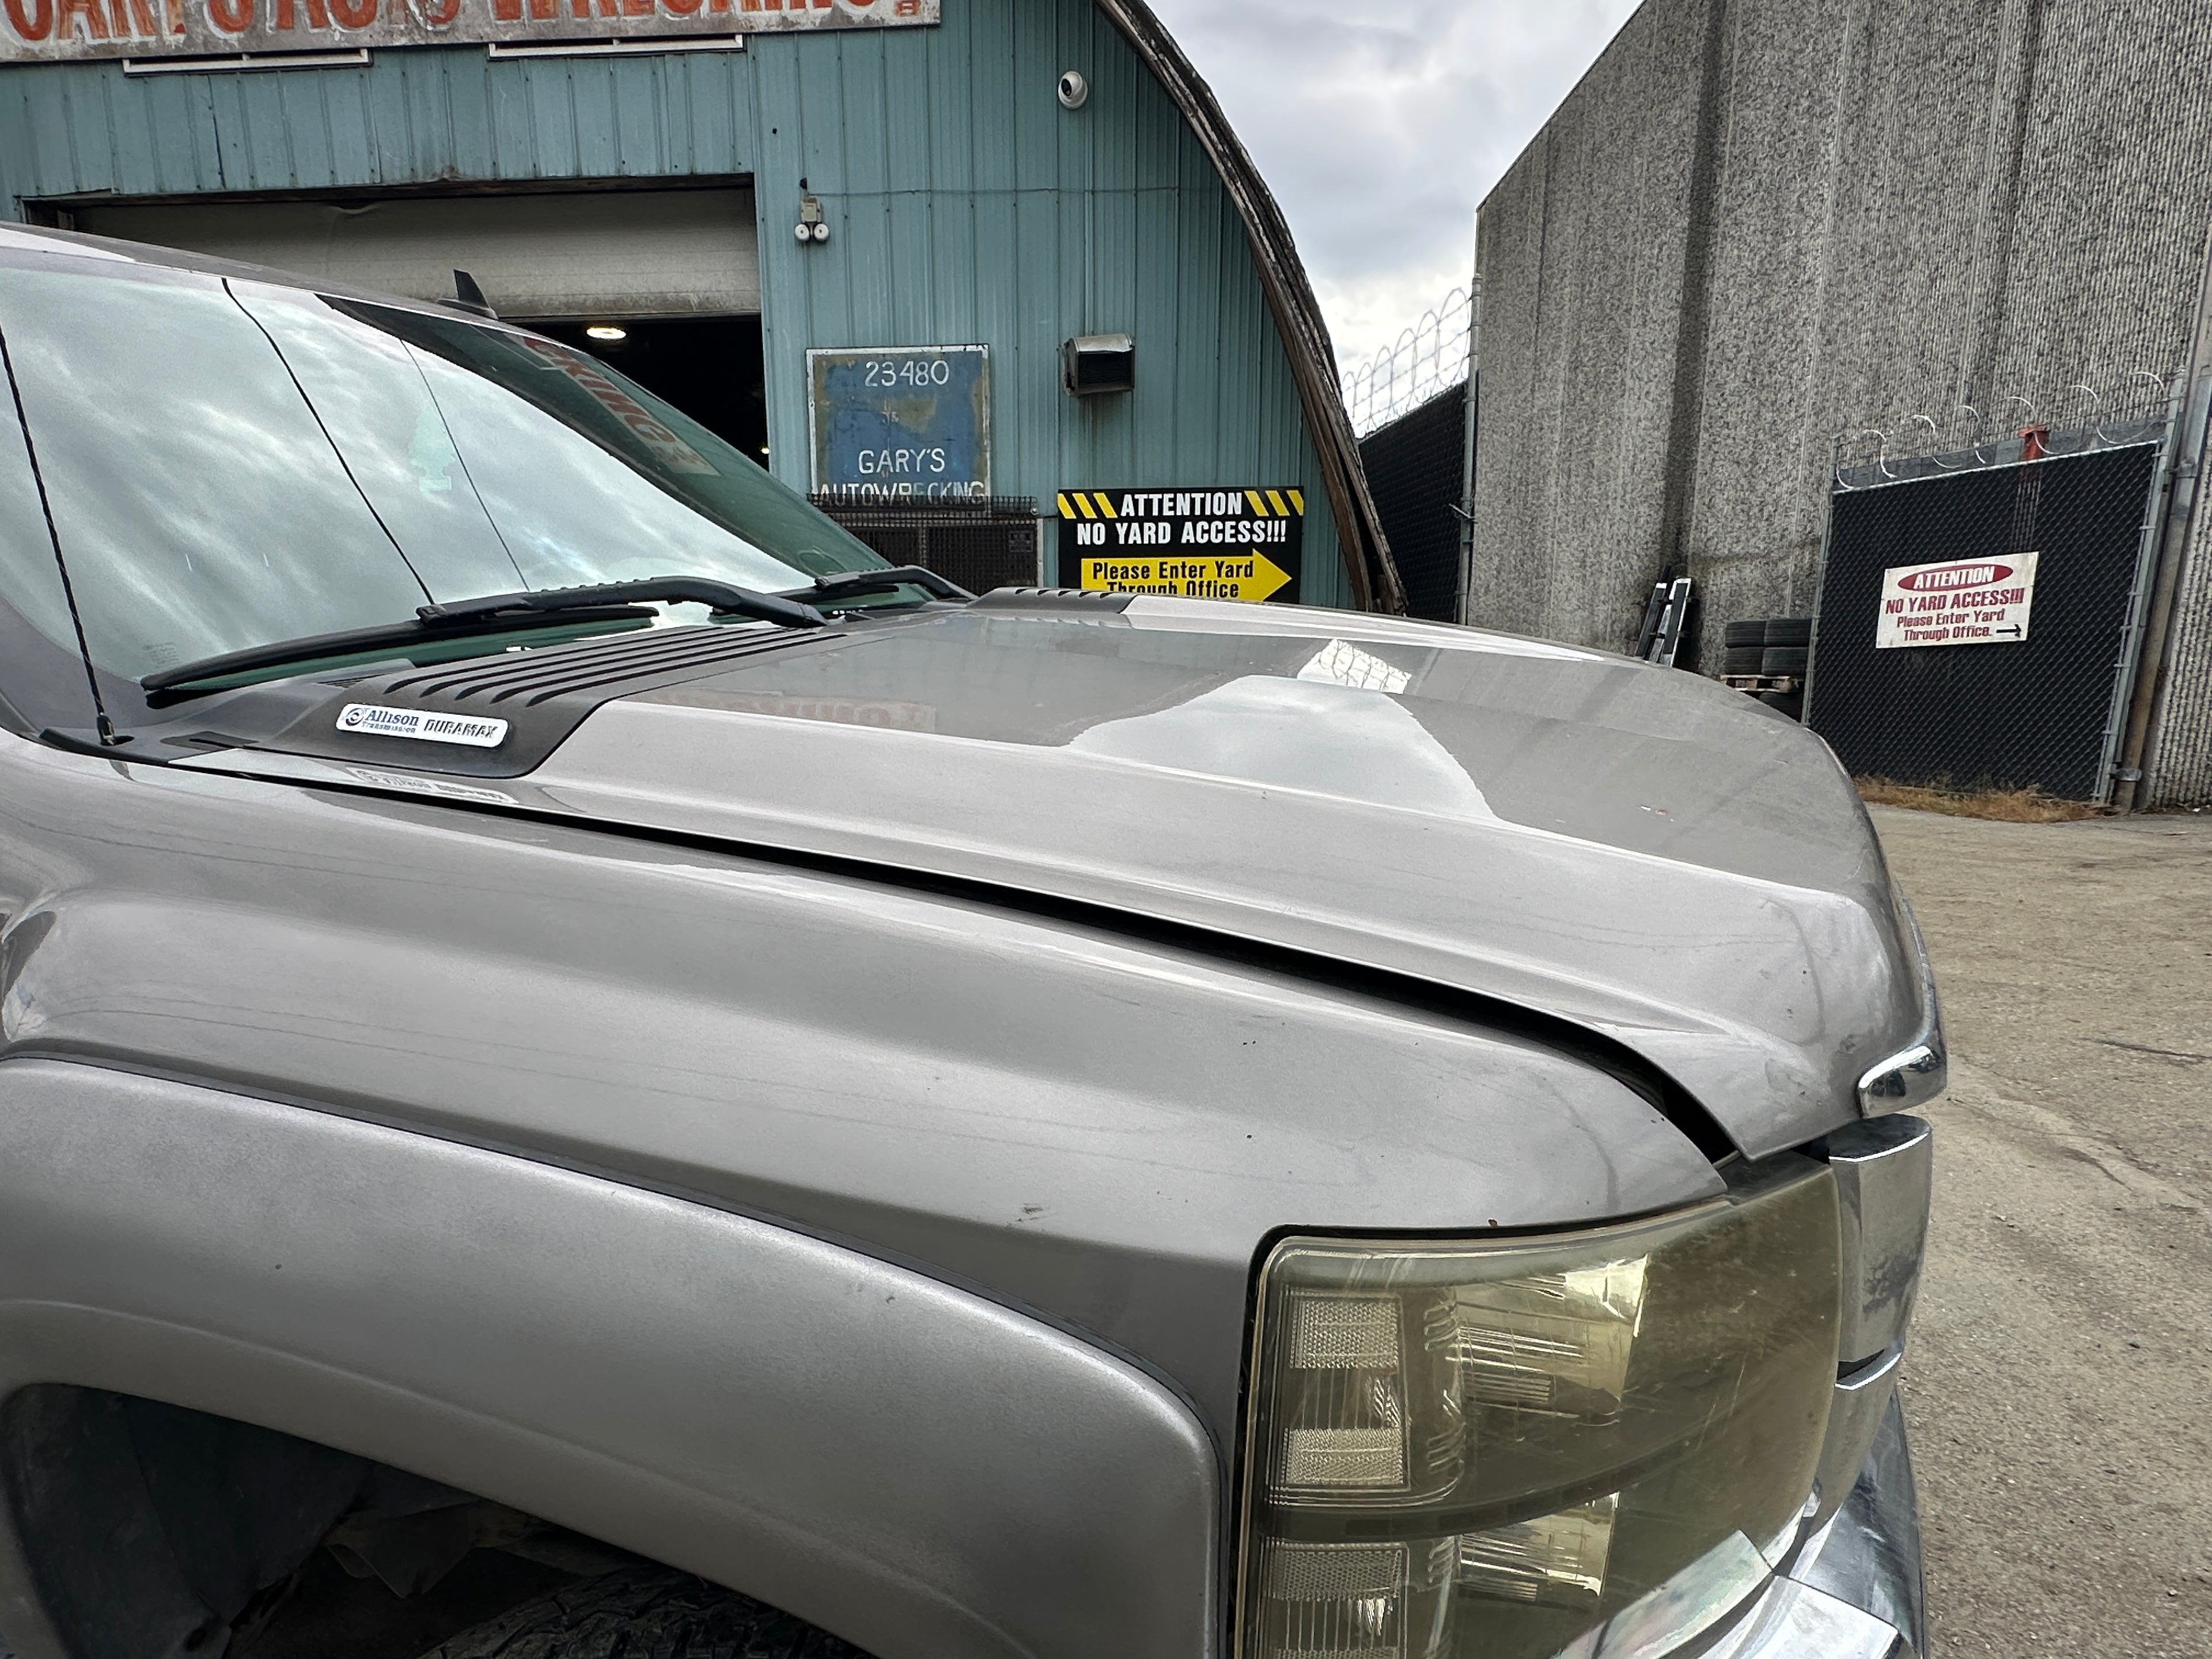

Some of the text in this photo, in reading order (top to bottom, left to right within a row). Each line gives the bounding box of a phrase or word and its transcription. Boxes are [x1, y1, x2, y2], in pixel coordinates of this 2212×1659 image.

[865, 360, 950, 387] 23480
[858, 448, 945, 474] GARY'S
[1120, 493, 1242, 517] ATTENTION
[1077, 520, 1286, 545] NO YARD ACCESS!!!
[1093, 560, 1254, 580] Please Enter Yard
[1913, 566, 1995, 589] ATTENTION
[1185, 579, 1239, 597] Office
[1885, 588, 2025, 614] NO YARD ACCESS!!!
[1897, 608, 2005, 628] Please Enter Yard
[1904, 627, 1949, 642] Through
[365, 709, 419, 726] Allison
[423, 719, 498, 738] DURAMAX
